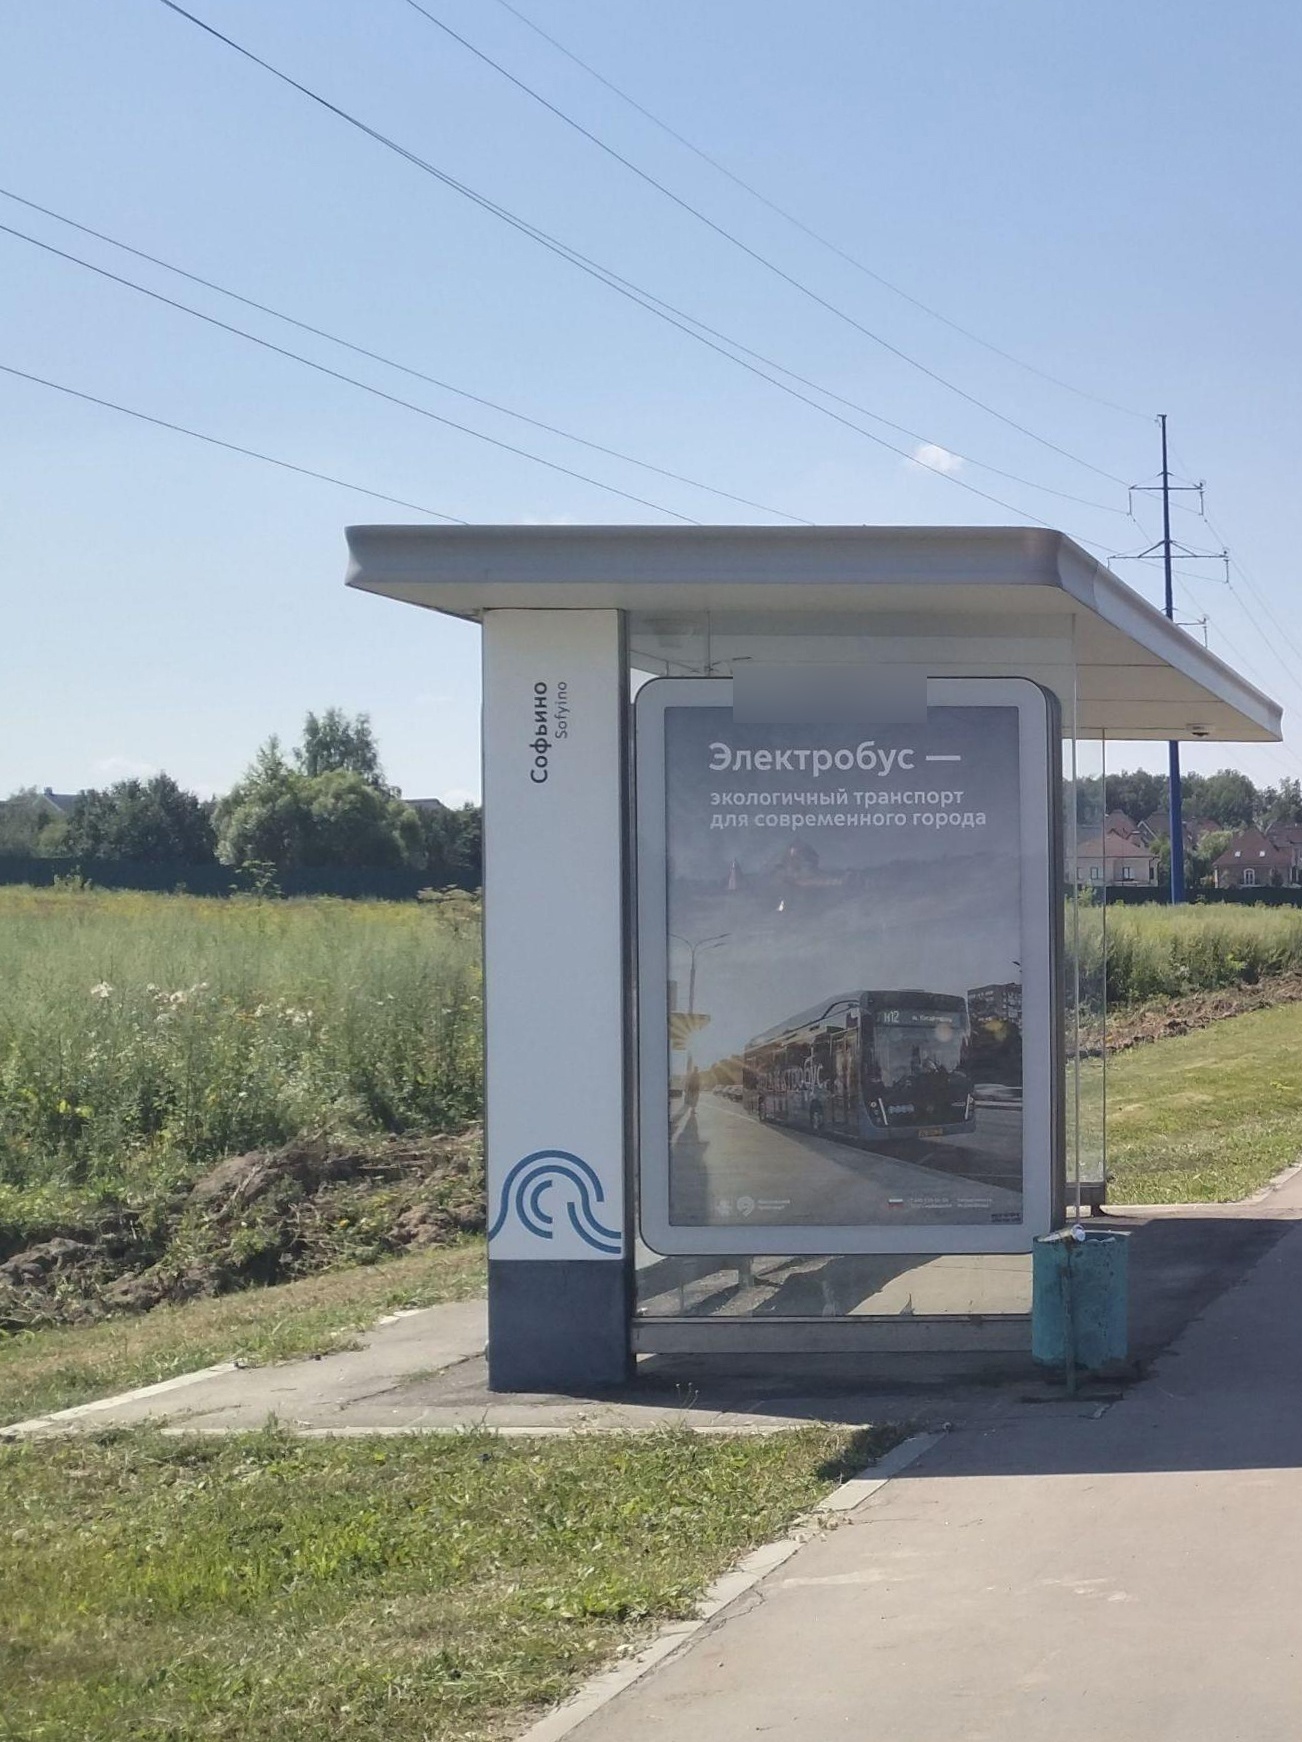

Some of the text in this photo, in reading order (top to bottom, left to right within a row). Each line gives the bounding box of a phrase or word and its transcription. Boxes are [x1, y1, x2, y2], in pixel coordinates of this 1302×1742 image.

[554, 681, 570, 739] Sofyino
[529, 681, 552, 784] Софьино
[708, 740, 915, 777] Электробус
[710, 788, 964, 809] экологичный транспорт
[710, 811, 987, 831] для современного города
